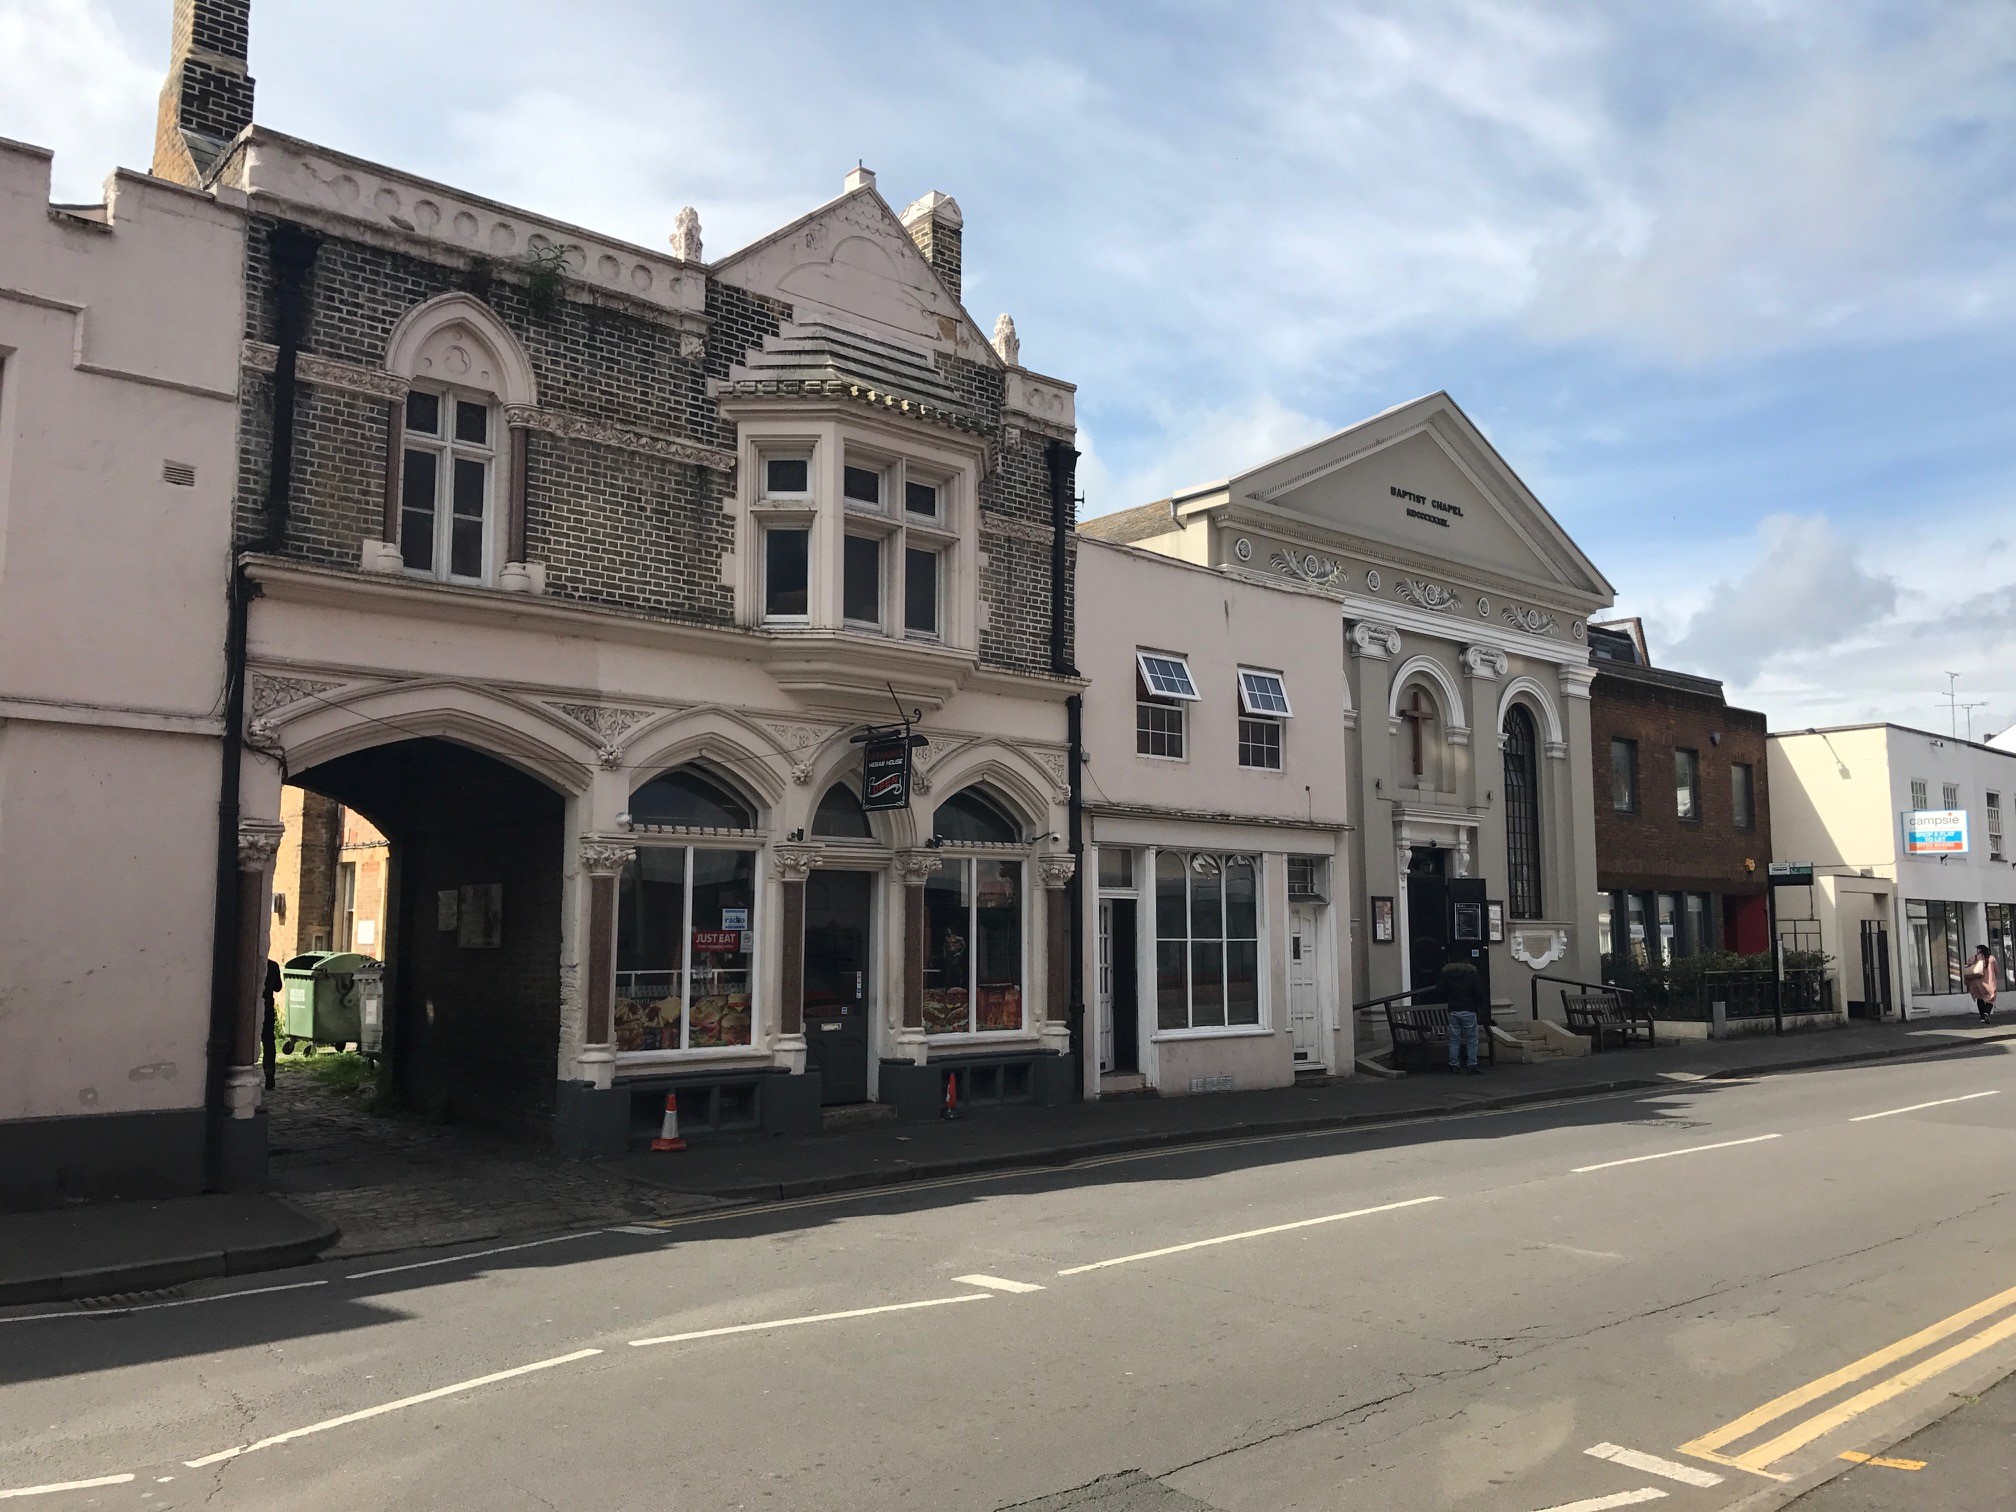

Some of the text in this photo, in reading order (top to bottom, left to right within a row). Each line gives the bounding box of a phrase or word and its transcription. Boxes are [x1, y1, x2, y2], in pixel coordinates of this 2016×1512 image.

[1390, 486, 1427, 505] BAPTIST
[886, 758, 903, 766] HOUSE
[872, 775, 898, 795] OPEN
[1909, 812, 1960, 827] campsie
[724, 915, 745, 924] radio
[696, 933, 736, 943] JUST EAT
